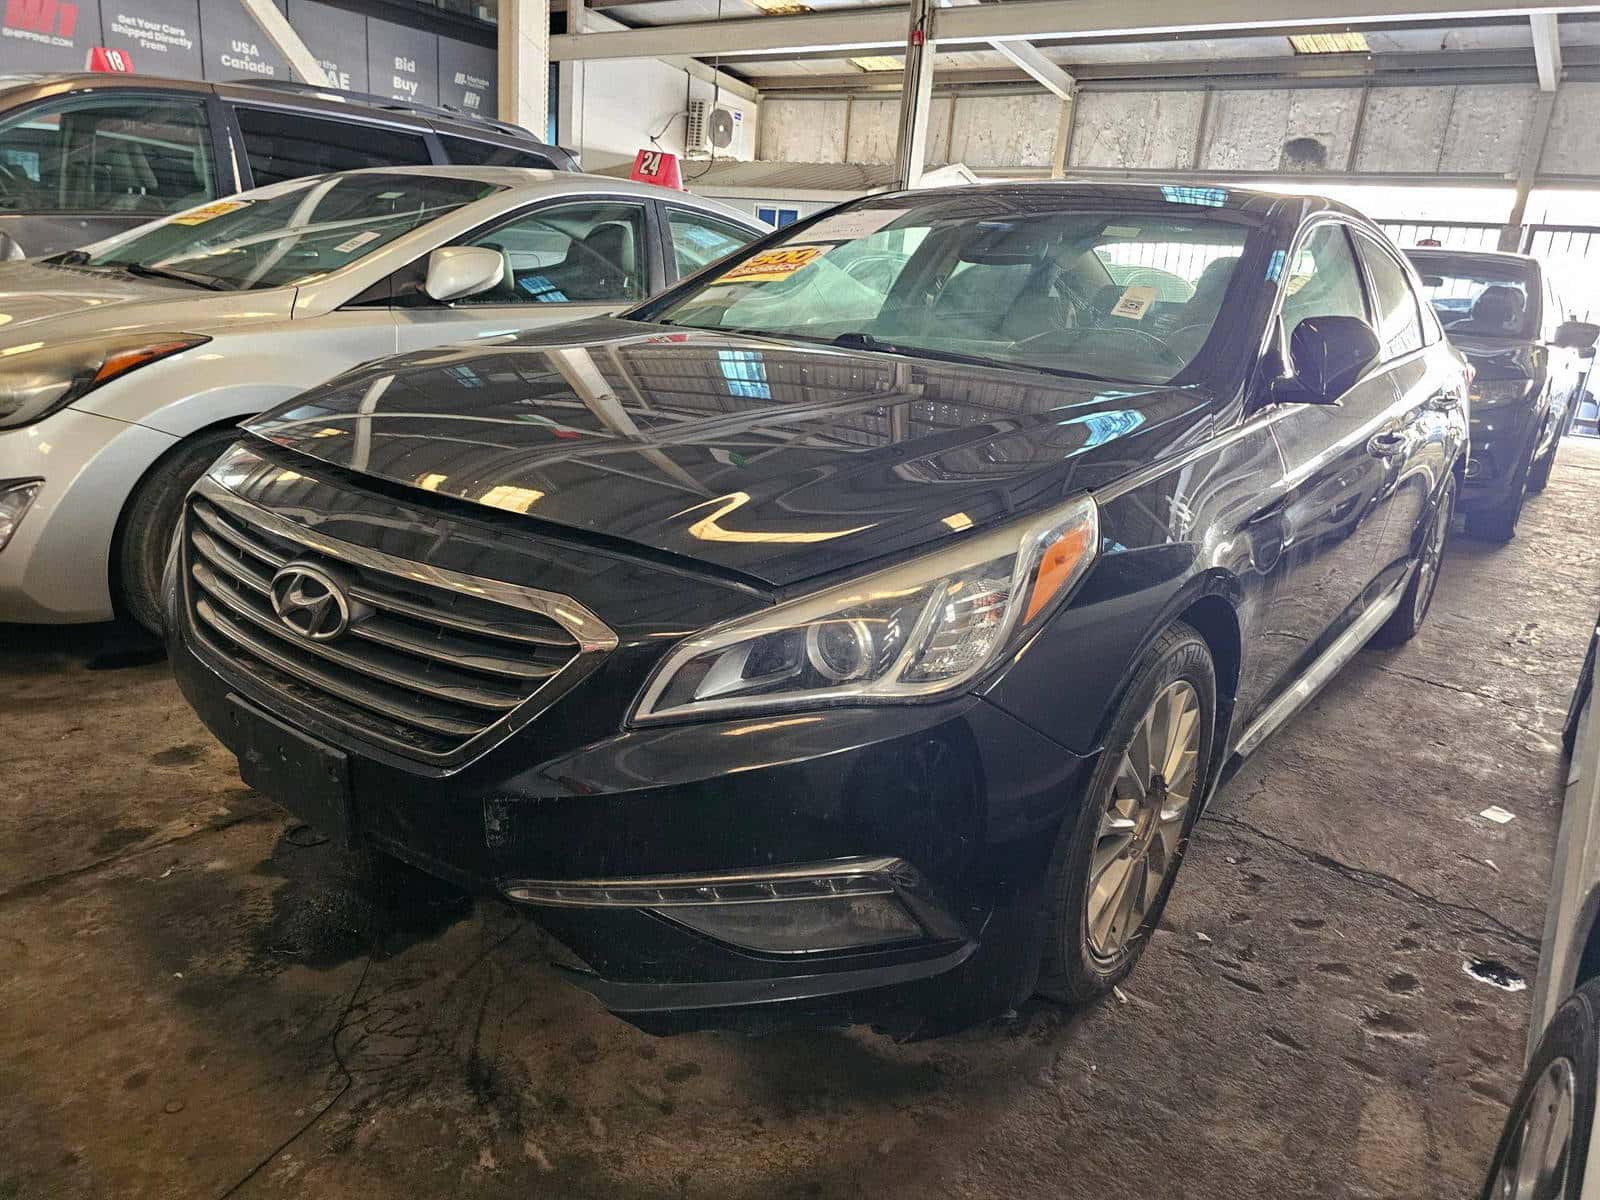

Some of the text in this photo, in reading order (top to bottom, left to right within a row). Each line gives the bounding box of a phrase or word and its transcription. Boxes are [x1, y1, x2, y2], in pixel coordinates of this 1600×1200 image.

[118, 14, 185, 36] Get Your Cars
[112, 23, 192, 50] Shipped Directly
[141, 39, 167, 52] From
[232, 40, 259, 57] USA
[105, 50, 126, 71] 18
[221, 54, 274, 76] Canada
[394, 57, 416, 73] Bid
[393, 76, 418, 96] Buy
[640, 152, 661, 176] 24
